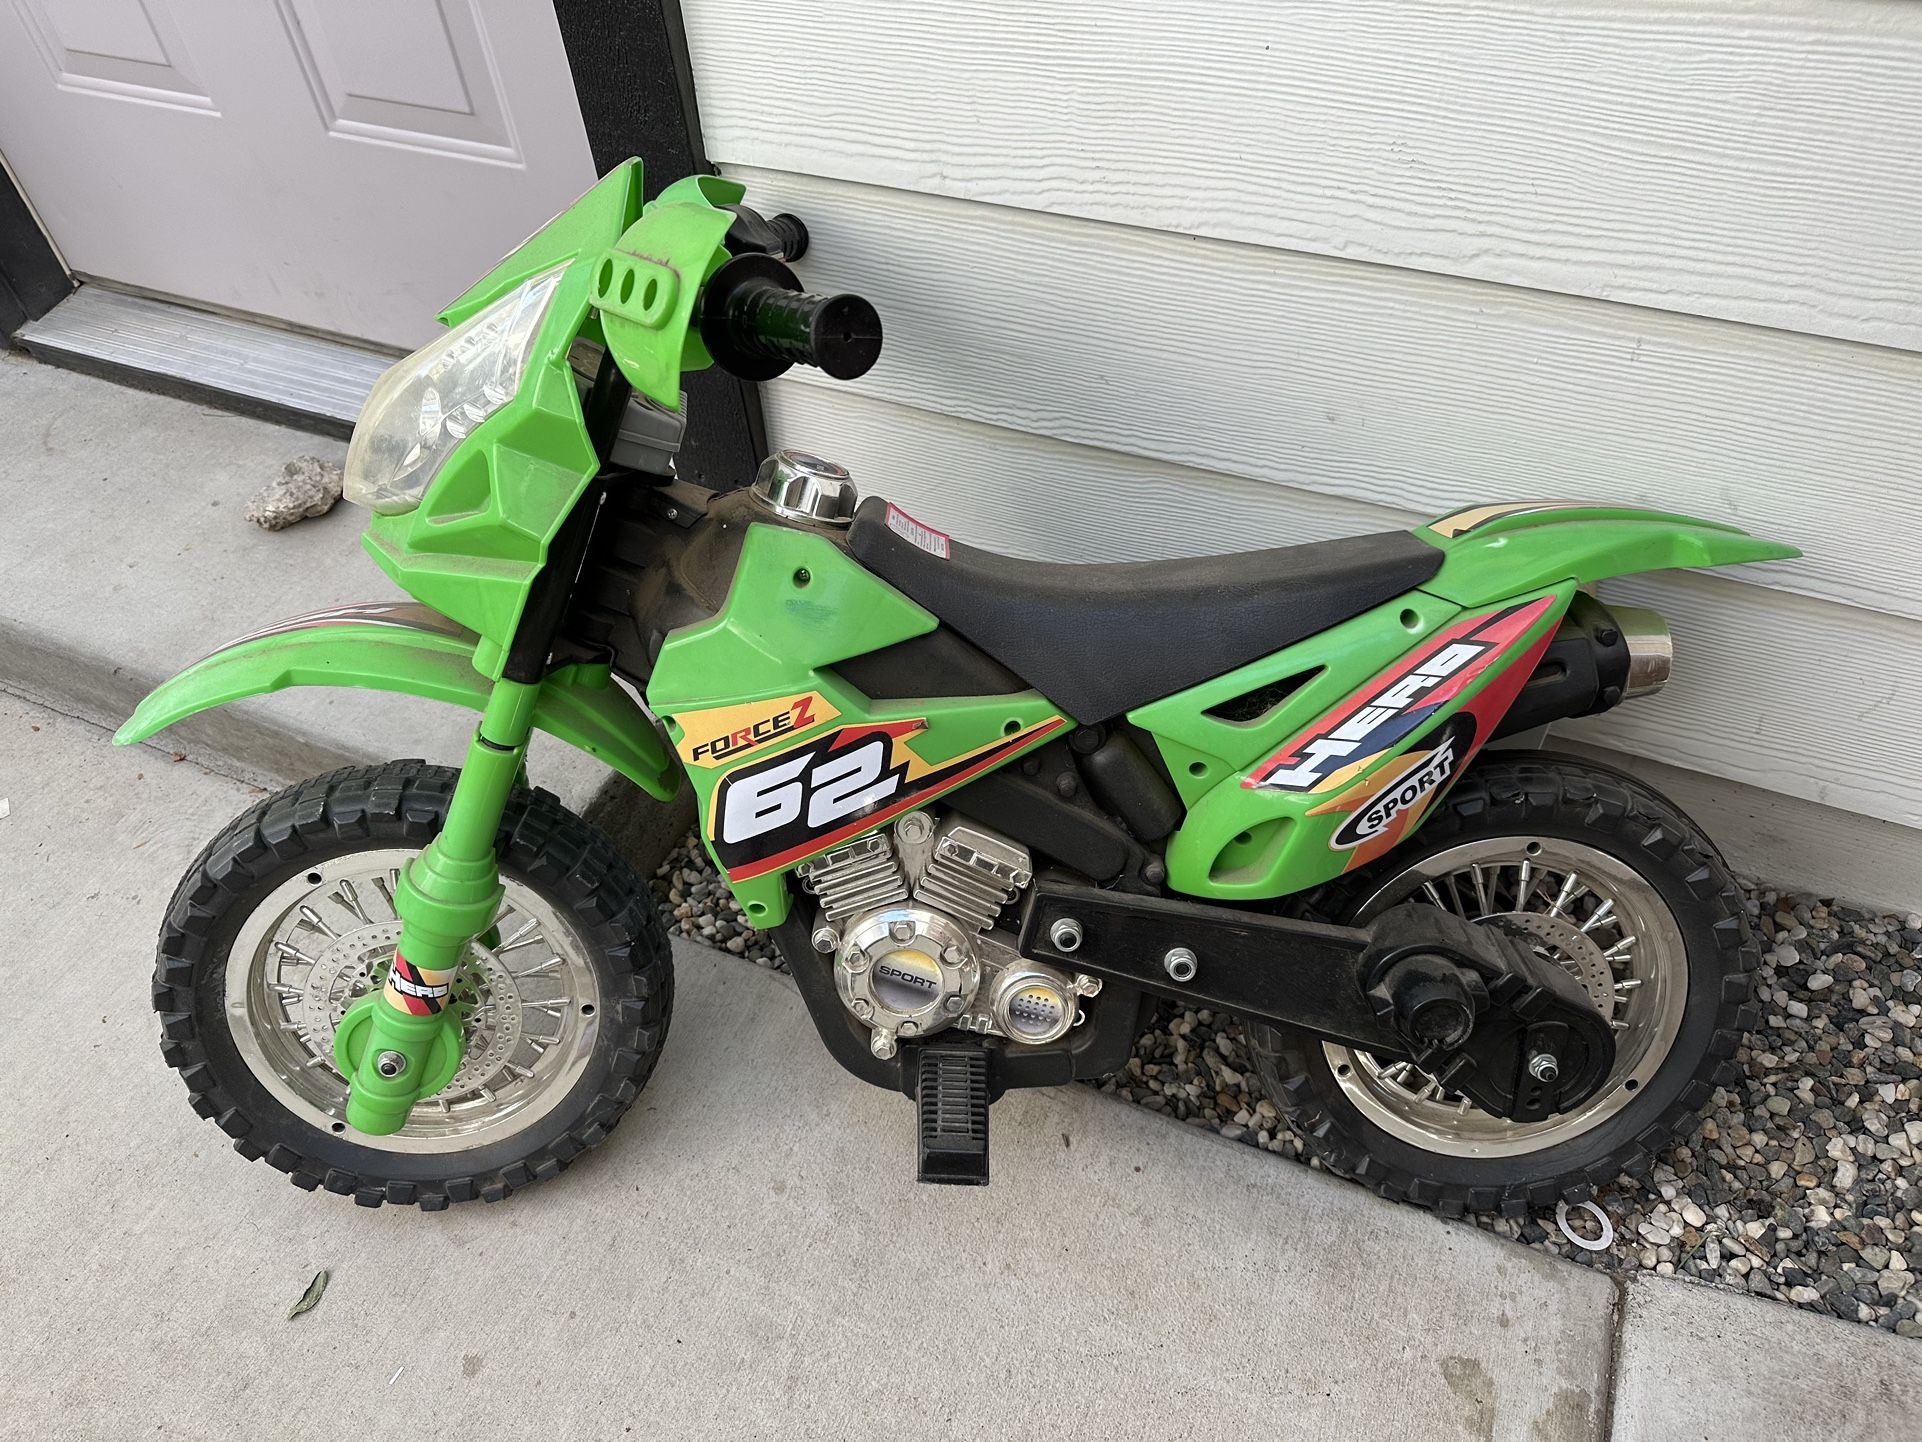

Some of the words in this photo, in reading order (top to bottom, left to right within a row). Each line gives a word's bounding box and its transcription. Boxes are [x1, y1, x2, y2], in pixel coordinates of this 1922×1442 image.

[723, 740, 900, 844] 62
[1366, 755, 1455, 830] SPORT
[879, 965, 937, 989] SPORT
